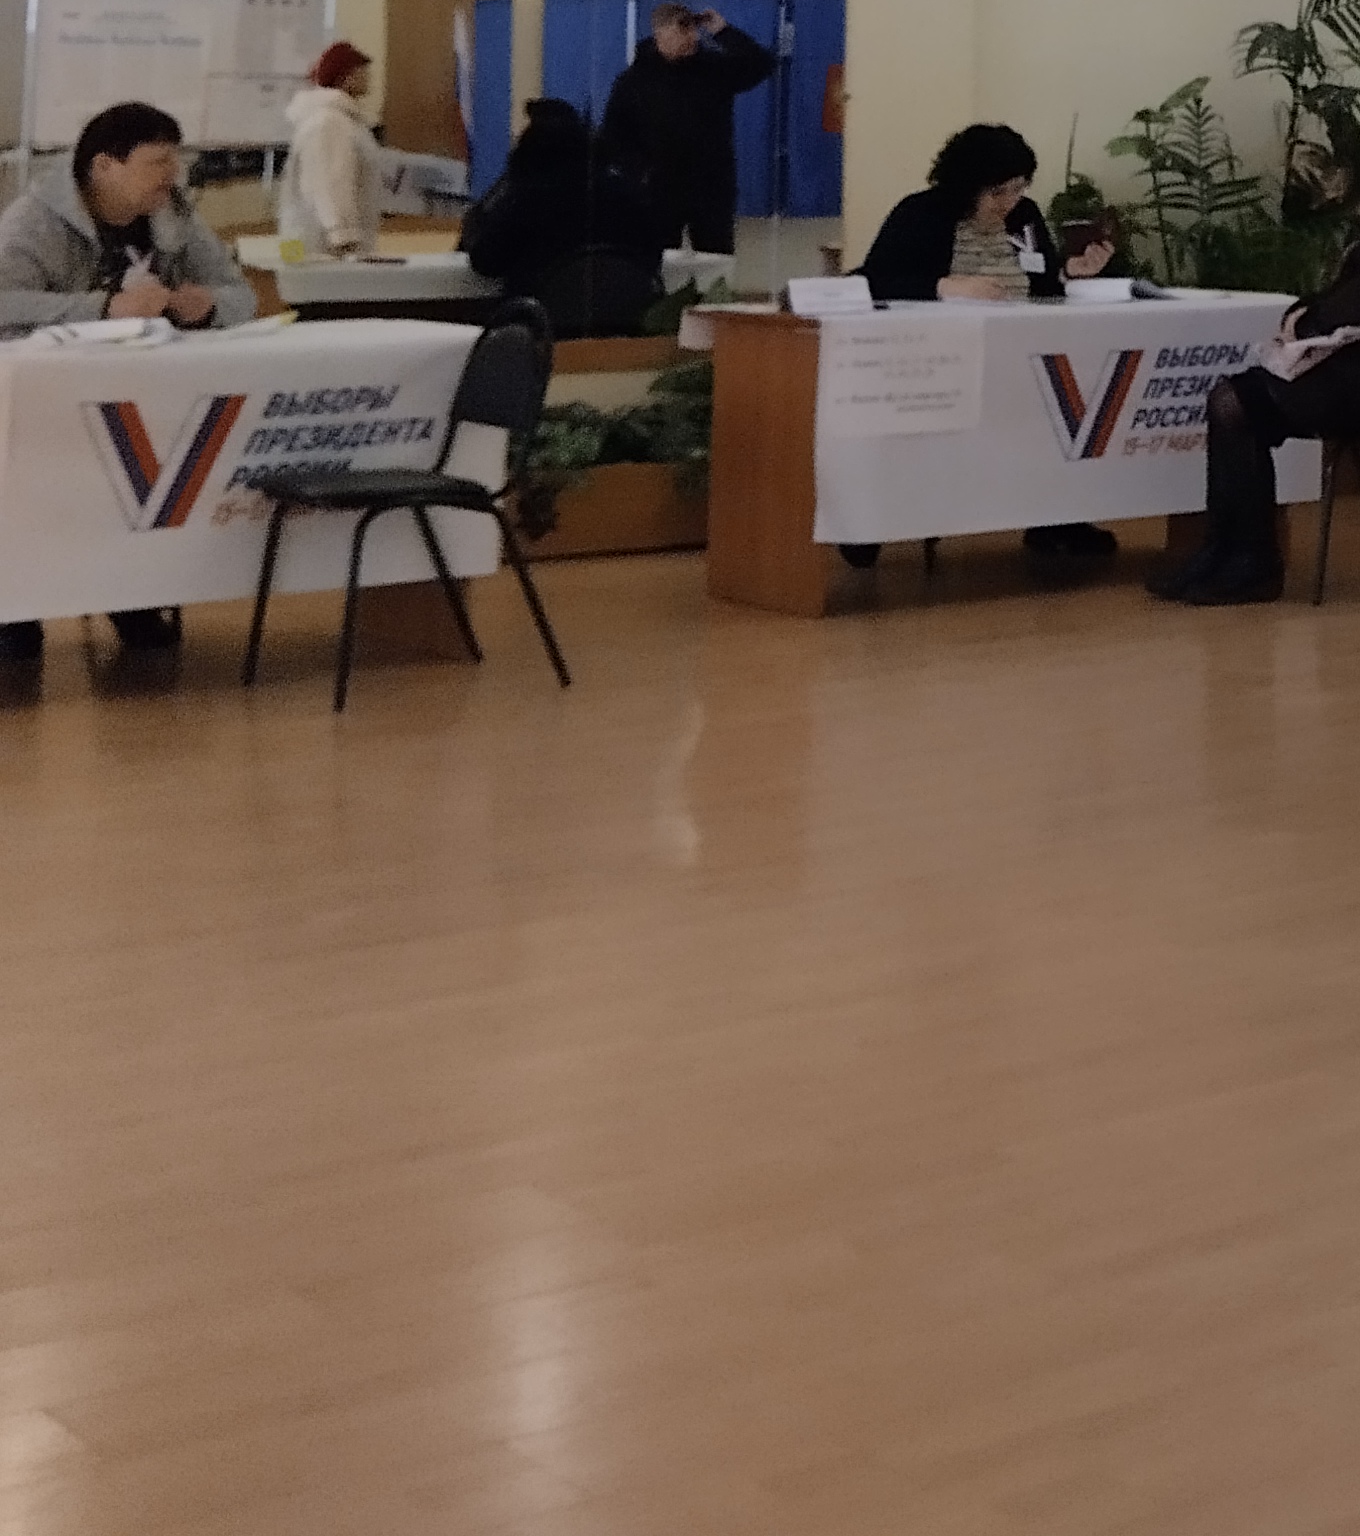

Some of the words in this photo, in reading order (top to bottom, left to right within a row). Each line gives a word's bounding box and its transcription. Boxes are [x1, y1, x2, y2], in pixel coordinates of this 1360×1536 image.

[1154, 343, 1251, 369] ВЫБОРЫ
[1142, 375, 1214, 400] ПРЕЗИ
[262, 384, 400, 418] ВЫБОРЫ
[1130, 405, 1208, 430] РОССИ
[243, 417, 435, 455] ПРЕЗИДЕНТА
